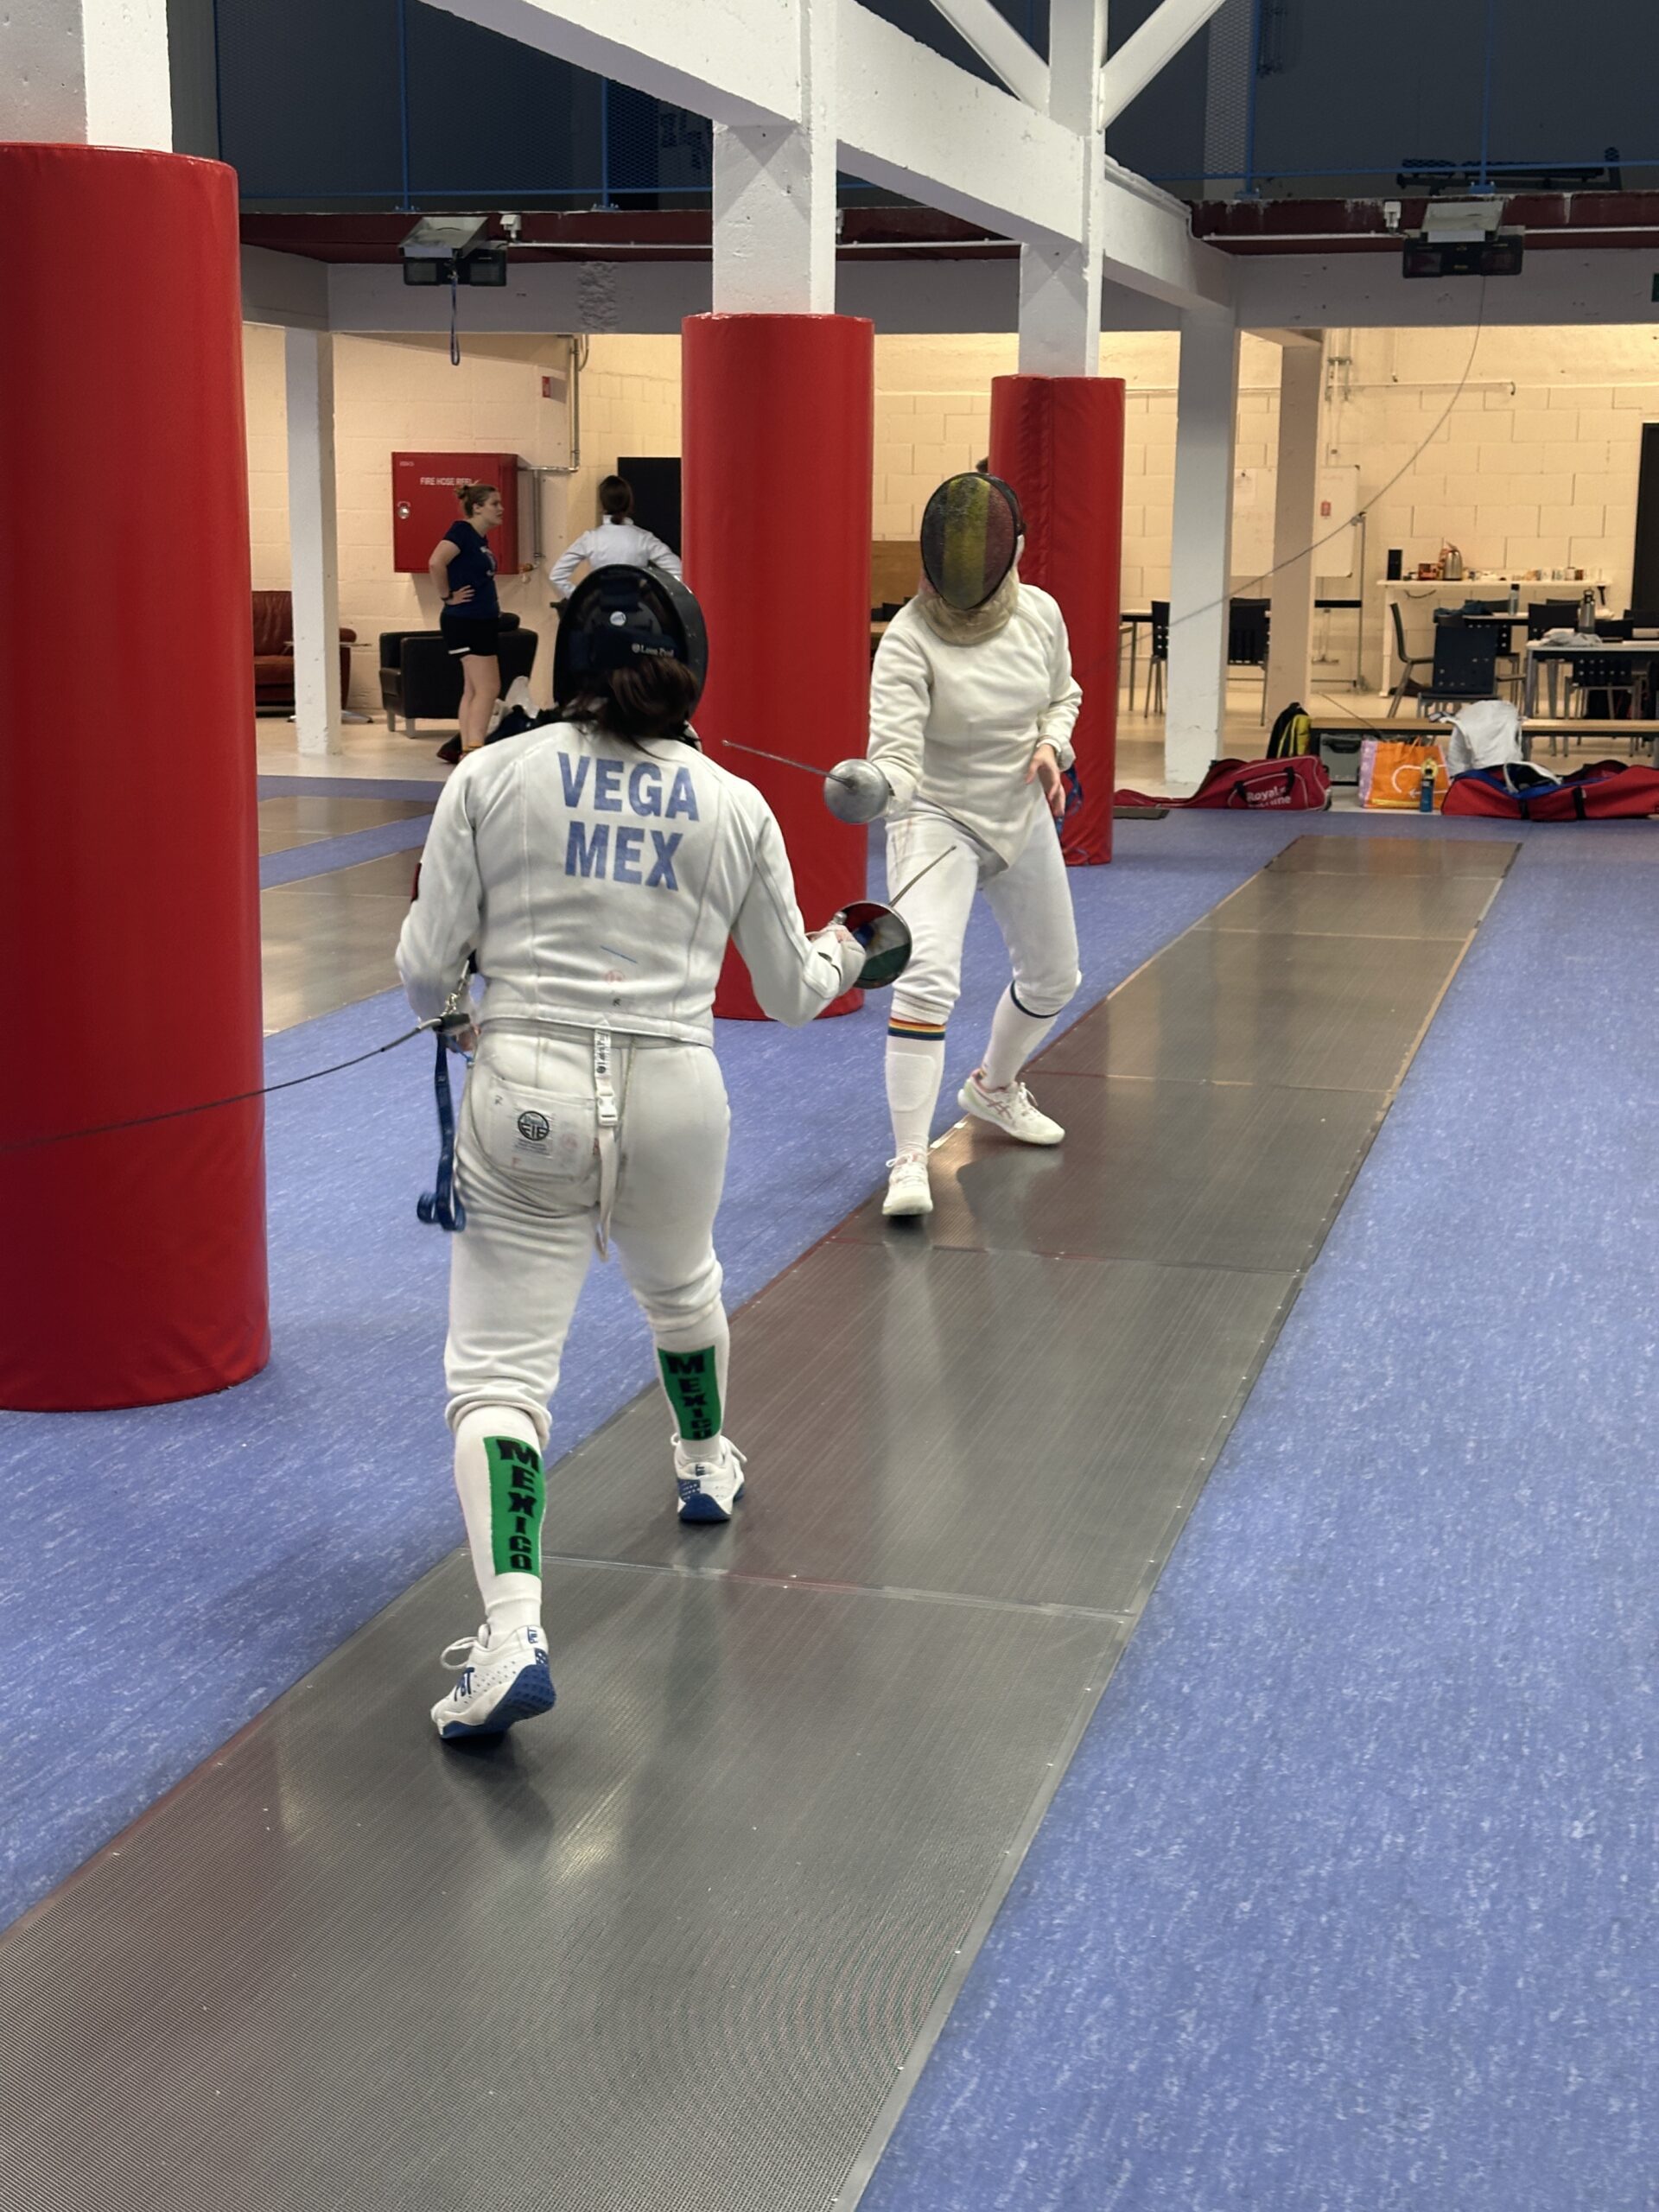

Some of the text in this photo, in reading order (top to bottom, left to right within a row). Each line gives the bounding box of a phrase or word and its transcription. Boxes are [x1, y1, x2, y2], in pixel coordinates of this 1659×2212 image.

[420, 477, 435, 486] FIRE
[436, 477, 454, 486] HOSE
[557, 751, 700, 822] VEGA
[564, 820, 683, 891] MEX
[664, 1353, 712, 1440] MEXICO
[495, 1438, 539, 1571] MEXICO
